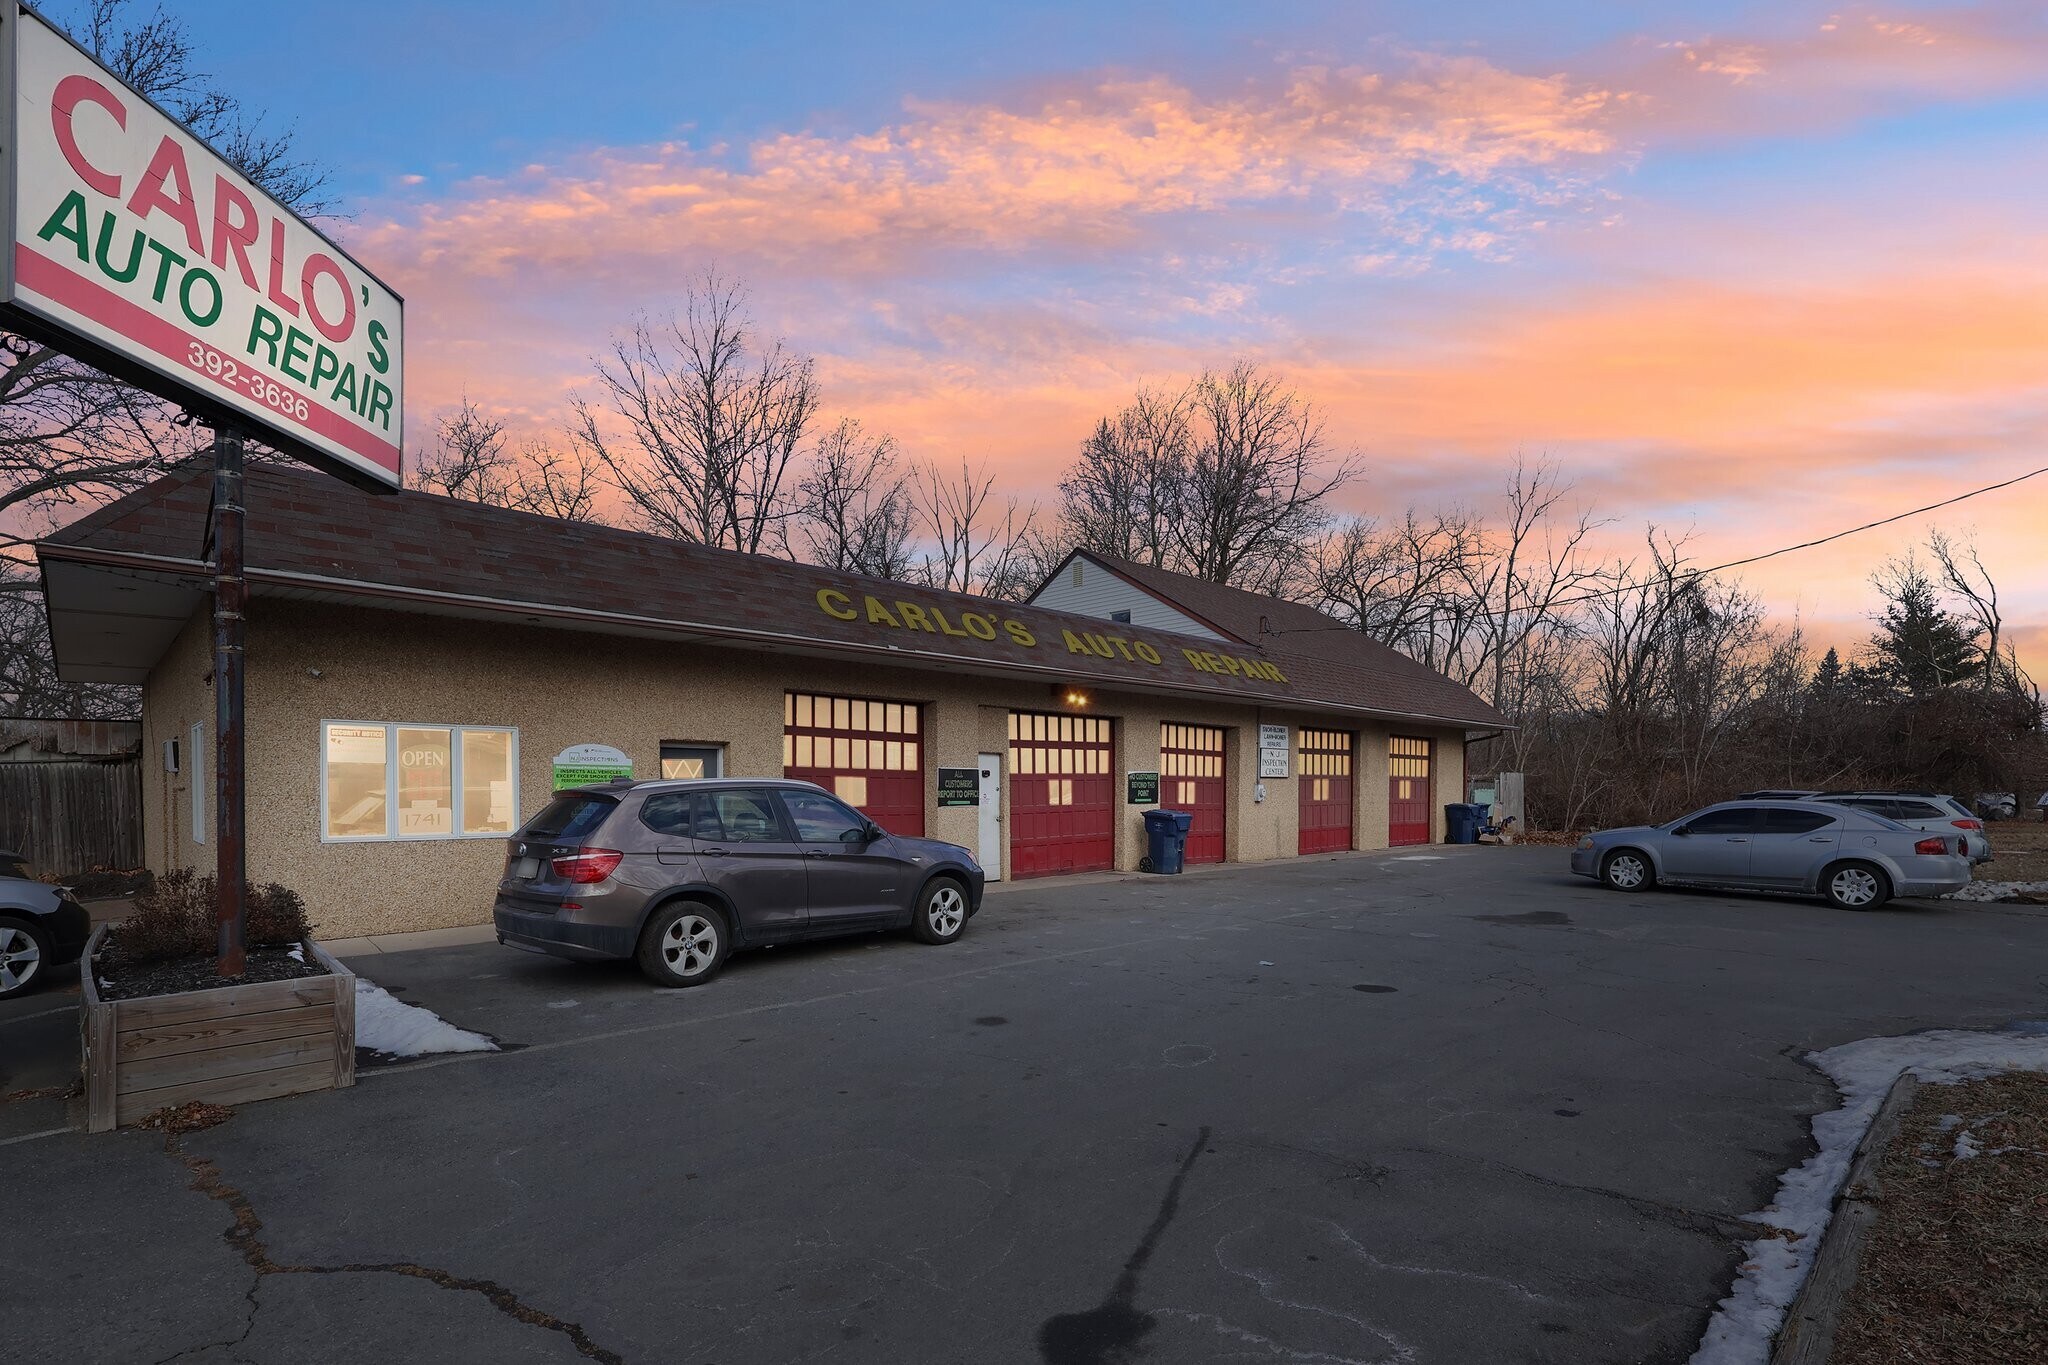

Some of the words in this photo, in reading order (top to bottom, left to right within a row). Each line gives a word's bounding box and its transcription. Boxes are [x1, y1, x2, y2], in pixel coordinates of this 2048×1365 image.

[51, 75, 390, 375] CARLO'S
[37, 190, 223, 327] AUTO
[246, 304, 393, 431] REPAIR
[188, 342, 309, 421] 392-3636
[816, 588, 1037, 647] CARLO'S
[1062, 629, 1162, 665] AUTO
[1182, 647, 1289, 683] REPAIR
[401, 750, 444, 767] OPEN
[1262, 759, 1287, 767] INSPECTION
[944, 780, 973, 788] CUSTOMERS
[957, 790, 963, 798] TO
[404, 813, 441, 827] 1741
